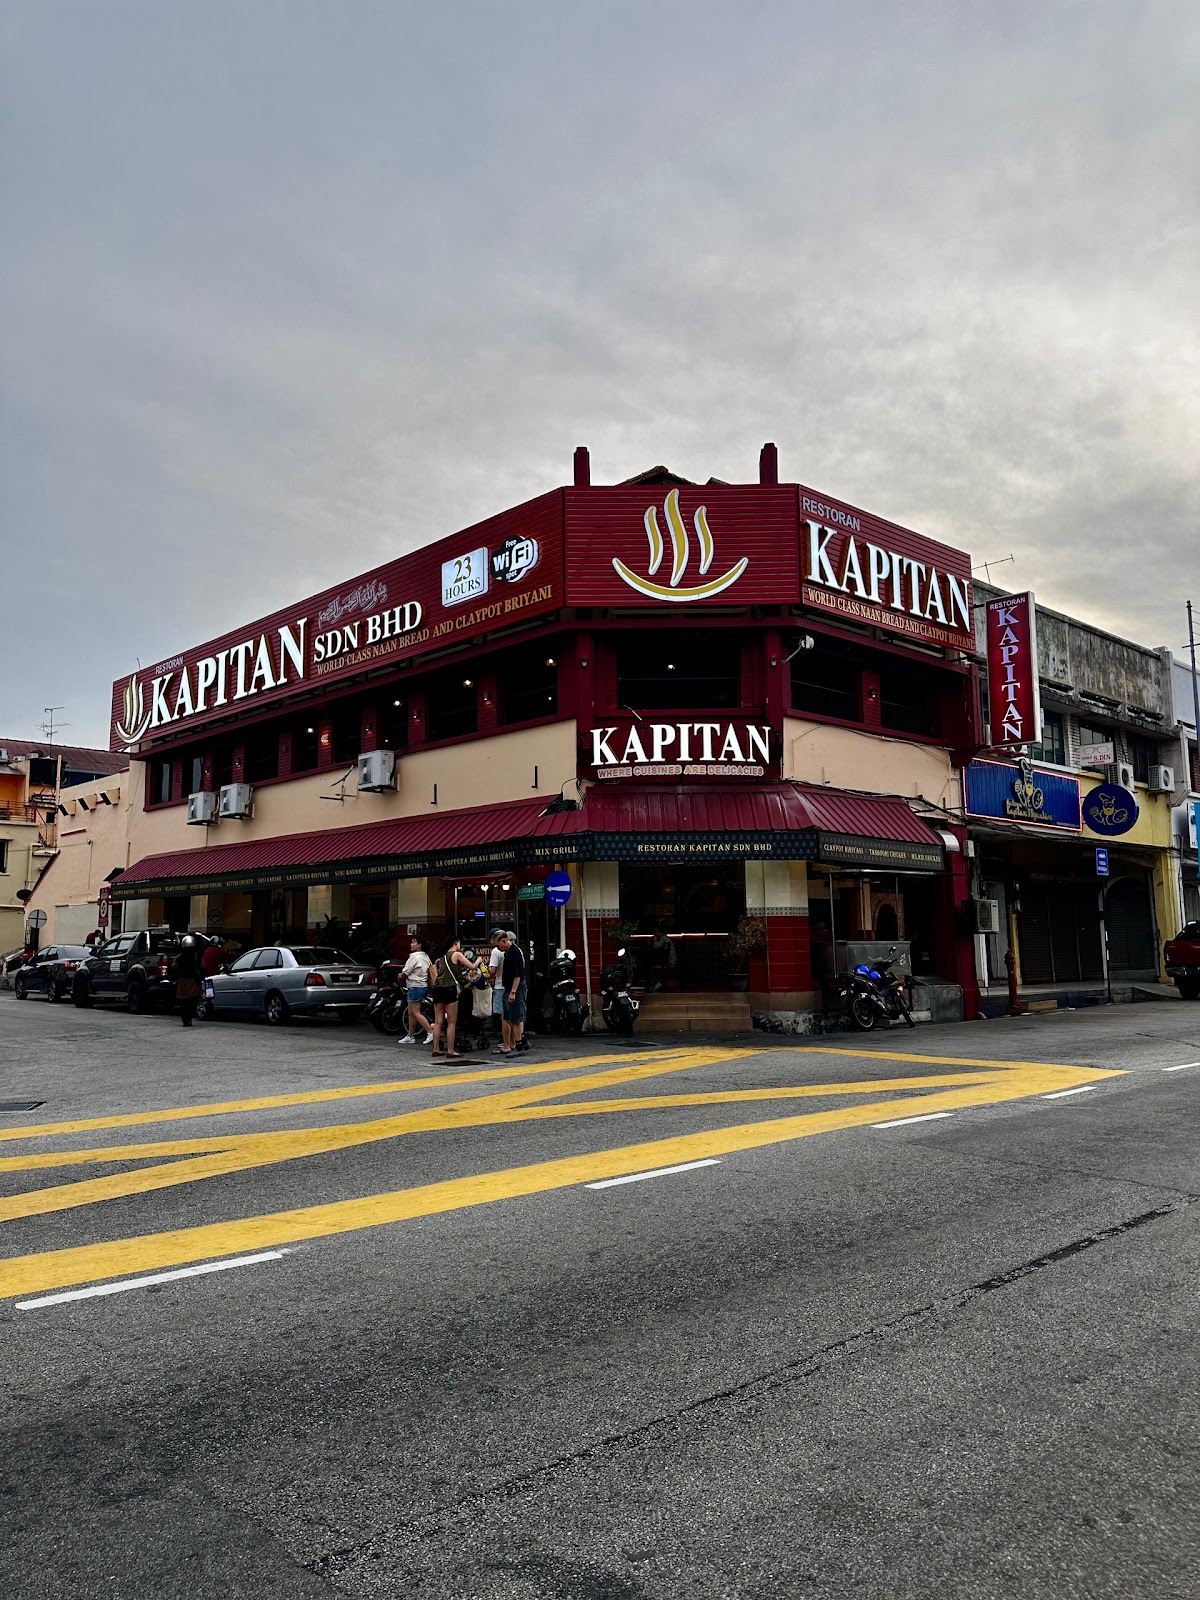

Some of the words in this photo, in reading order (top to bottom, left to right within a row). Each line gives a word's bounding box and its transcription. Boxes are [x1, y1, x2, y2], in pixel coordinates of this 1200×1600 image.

[802, 496, 861, 532] RESTORAN
[505, 539, 517, 548] Free
[453, 555, 472, 584] 23
[505, 570, 518, 580] spot
[804, 518, 970, 633] KAPITAN
[445, 577, 481, 600] HOURS
[808, 587, 836, 608] WORLD
[837, 597, 860, 616] CLASS
[860, 604, 881, 622] NAAN
[881, 611, 904, 630] BREAD
[904, 619, 919, 634] AND
[920, 623, 948, 645] CLAYPOT
[989, 596, 1026, 611] RESTORAN
[313, 621, 360, 663] SDN
[366, 600, 423, 645] BHD
[317, 656, 345, 676] WORLD
[346, 648, 371, 667] CLASS
[372, 638, 398, 658] NAAN
[399, 628, 430, 650] BREAD
[432, 619, 454, 638] AND
[455, 602, 503, 630] CLAYPOT
[504, 584, 552, 613] BRIYANI
[149, 617, 308, 729] KAPITAN
[155, 656, 184, 676] RESTORAN
[997, 606, 1024, 741] KAPITAN
[590, 722, 771, 765] KAPITAN
[597, 766, 633, 779] WHERE
[633, 764, 683, 776] CUISINES
[683, 764, 707, 775] ARE
[707, 764, 764, 777] DELICACIES
[534, 848, 550, 856] MIX
[552, 846, 578, 855] GRILL
[637, 844, 686, 853] RESTORAN
[689, 844, 731, 853] KAPITAN
[733, 843, 751, 852] SDN
[753, 843, 772, 852] BHD
[435, 860, 445, 868] LA
